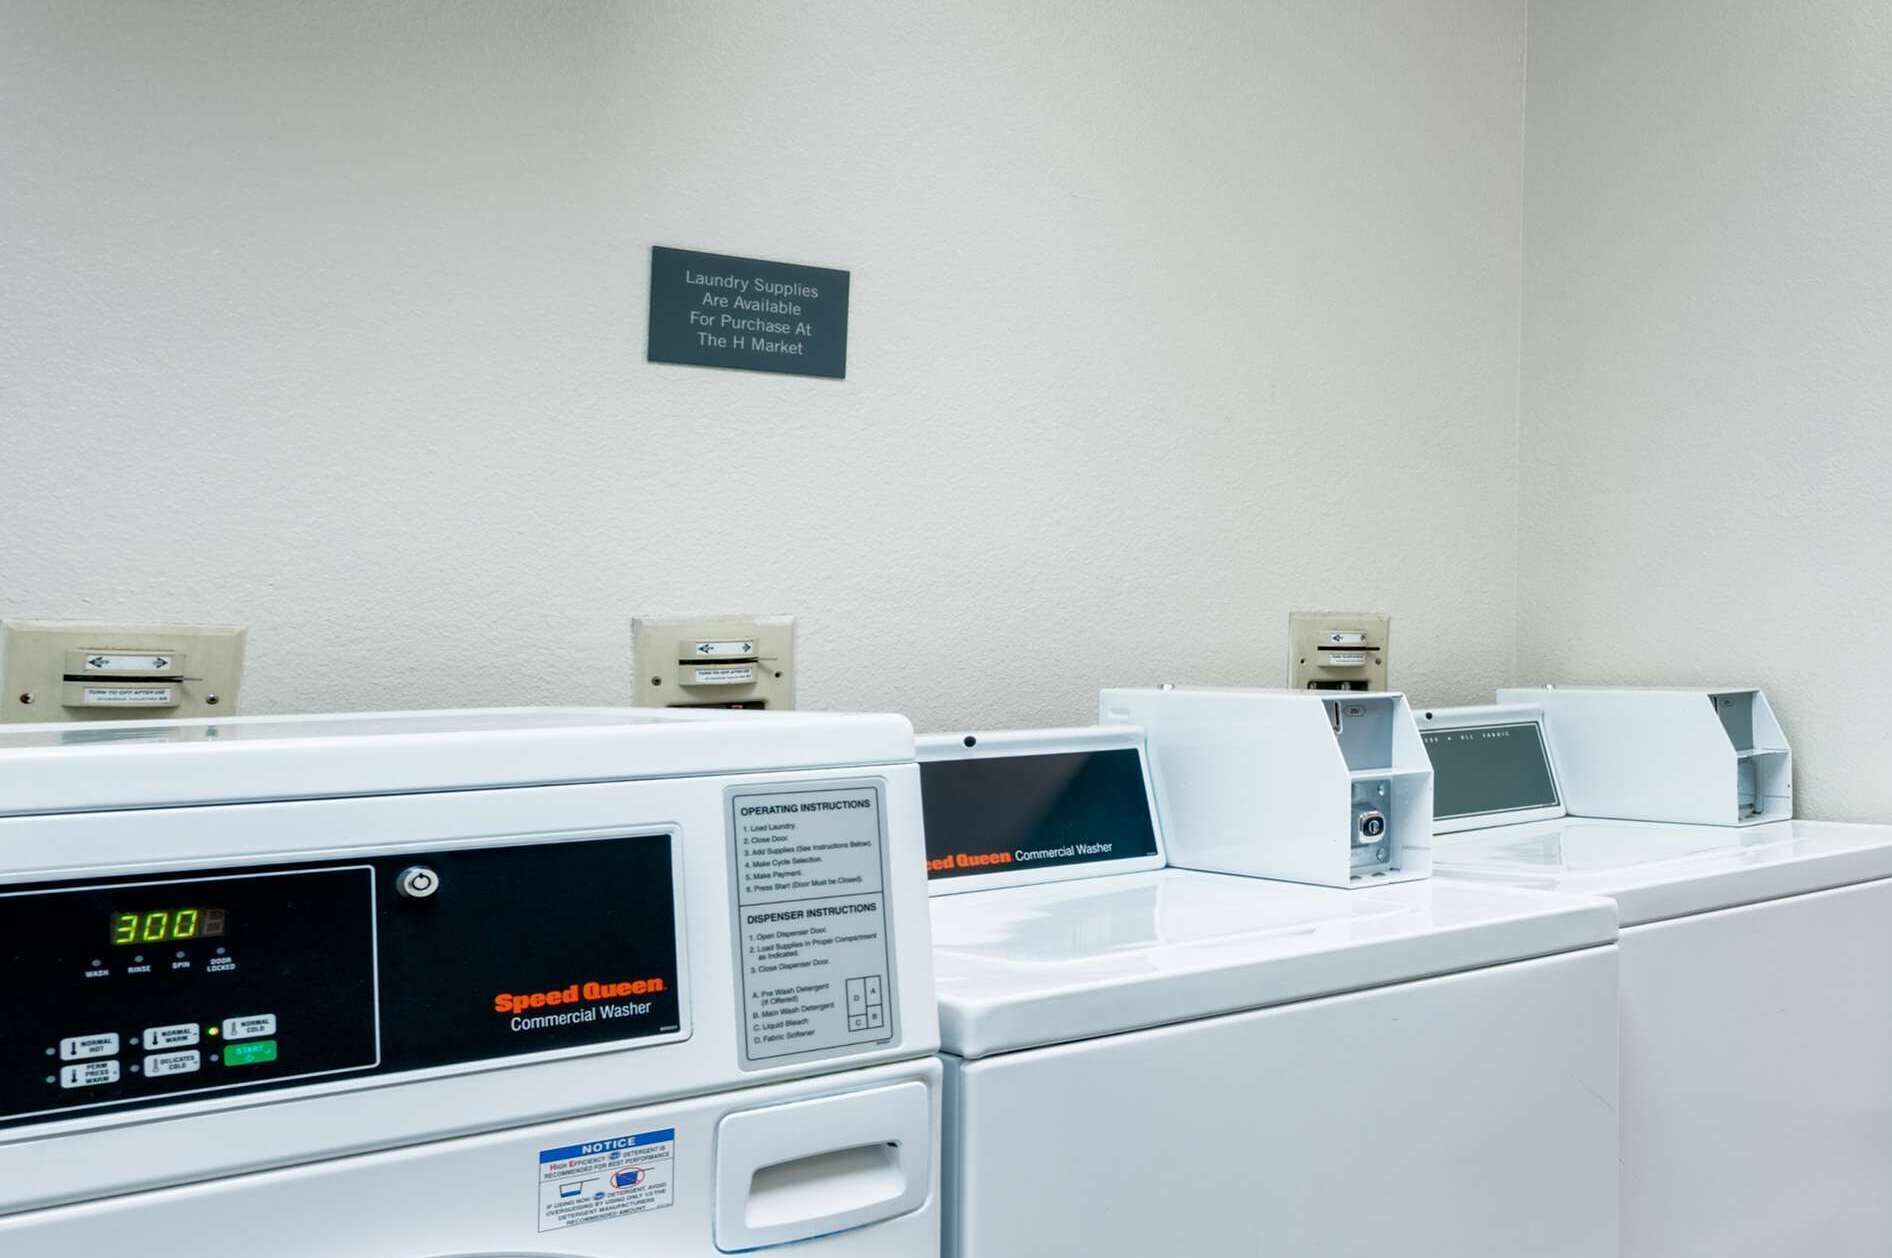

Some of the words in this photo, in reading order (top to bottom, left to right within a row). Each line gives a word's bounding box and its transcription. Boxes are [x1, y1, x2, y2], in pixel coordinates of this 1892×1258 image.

[686, 270, 749, 292] Laundry
[754, 278, 818, 298] Supplies
[702, 292, 728, 308] Are
[734, 296, 801, 316] Available
[690, 311, 713, 325] For
[721, 314, 790, 334] Purchase
[795, 323, 812, 336] At
[697, 332, 727, 347] The
[733, 336, 744, 349] H
[752, 337, 803, 355] Market
[740, 804, 798, 816] OPERATING
[800, 799, 870, 812] INSTRUCTIONS
[767, 847, 794, 855] Supplies
[956, 851, 1012, 867] Queen
[1015, 845, 1074, 862] Commercial
[1076, 842, 1112, 855] Washer
[747, 910, 803, 924] DISPENSER
[806, 903, 877, 917] INSTRUCTIONS
[116, 910, 198, 944] 300
[757, 944, 774, 952] Load
[812, 938, 833, 946] Proper
[835, 933, 877, 943] Compartment
[128, 965, 151, 974] RINSE
[172, 961, 190, 969] SPIN
[207, 964, 236, 972] LOCKED
[779, 961, 811, 970] Dispenser
[85, 970, 109, 978] WASH
[495, 984, 579, 1014] Speed
[583, 977, 664, 1001] Queen
[775, 987, 795, 995] Wash
[796, 984, 829, 993] Detergent
[801, 1002, 834, 1012] Detergent
[511, 1008, 596, 1031] Commercial
[600, 1002, 652, 1019] Washer
[763, 1021, 784, 1030] Liquid
[785, 1018, 808, 1026] Bleach
[81, 1038, 112, 1046] NORMAL
[763, 1034, 784, 1042] Fabric
[786, 1030, 815, 1039] Softener
[161, 1055, 194, 1064] DELICATES
[582, 1137, 636, 1154] NOTICE
[623, 1146, 659, 1158] DETERGENT
[608, 1159, 624, 1167] BEST
[625, 1152, 670, 1164] PERFORMANCE
